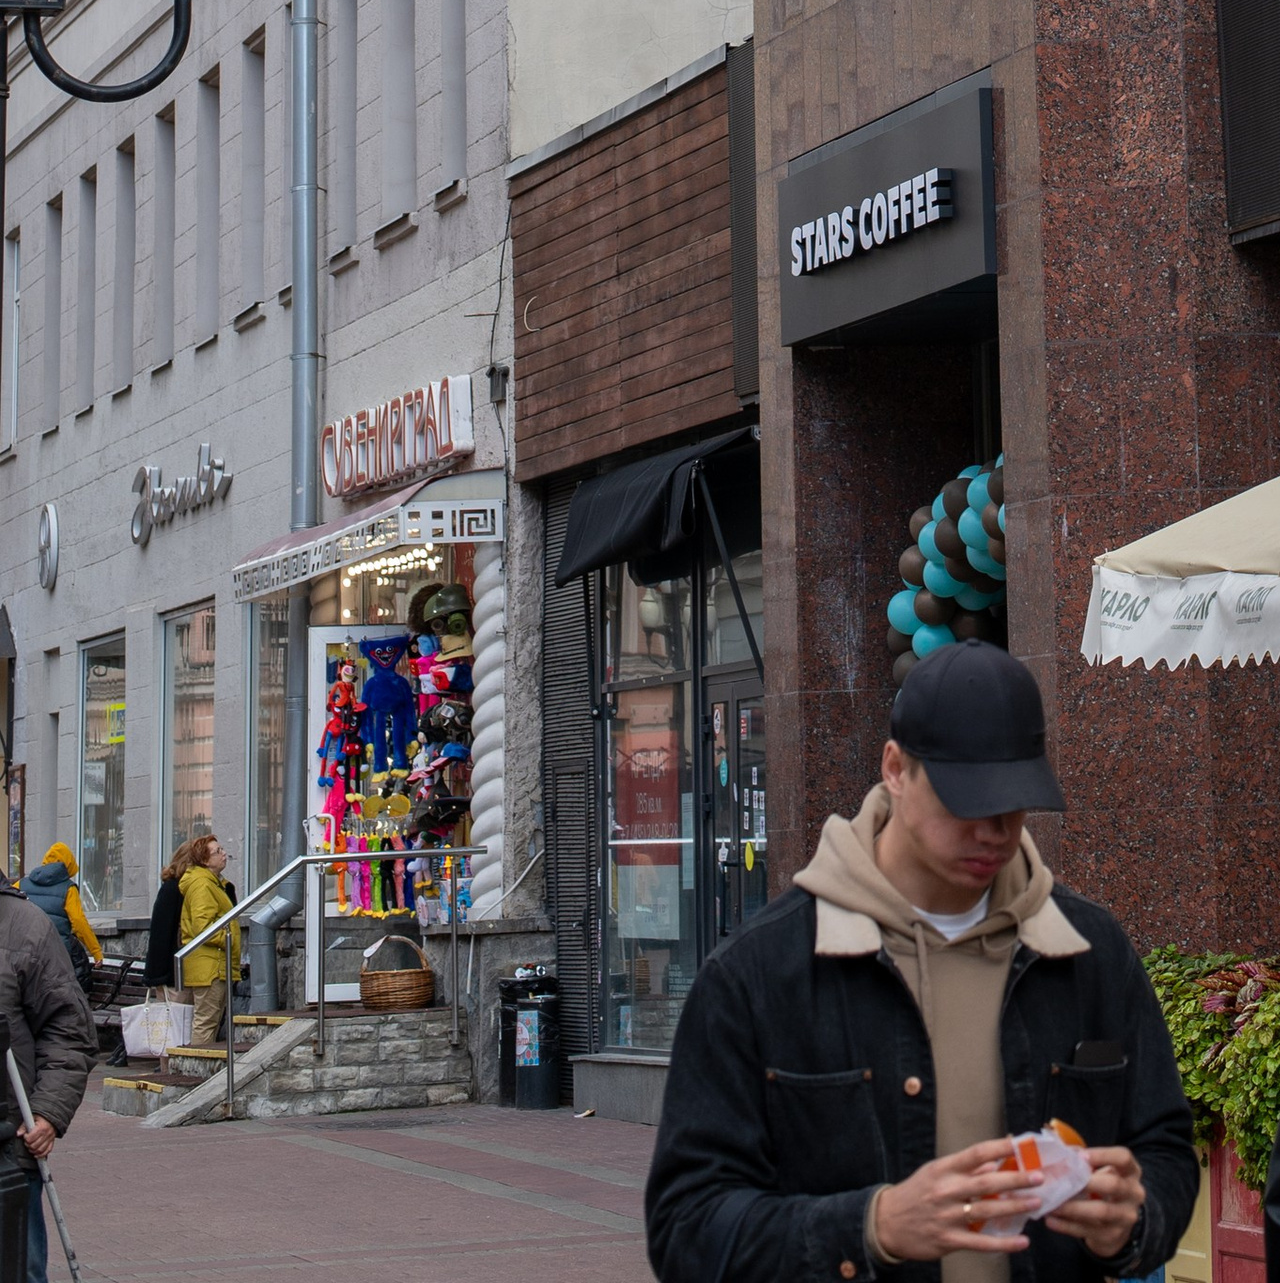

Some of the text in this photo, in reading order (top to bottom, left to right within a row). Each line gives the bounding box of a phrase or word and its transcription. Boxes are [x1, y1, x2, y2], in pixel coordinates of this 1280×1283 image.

[791, 167, 944, 277] STARS COFFEE
[321, 375, 456, 498] СУВЕНИРГРАД
